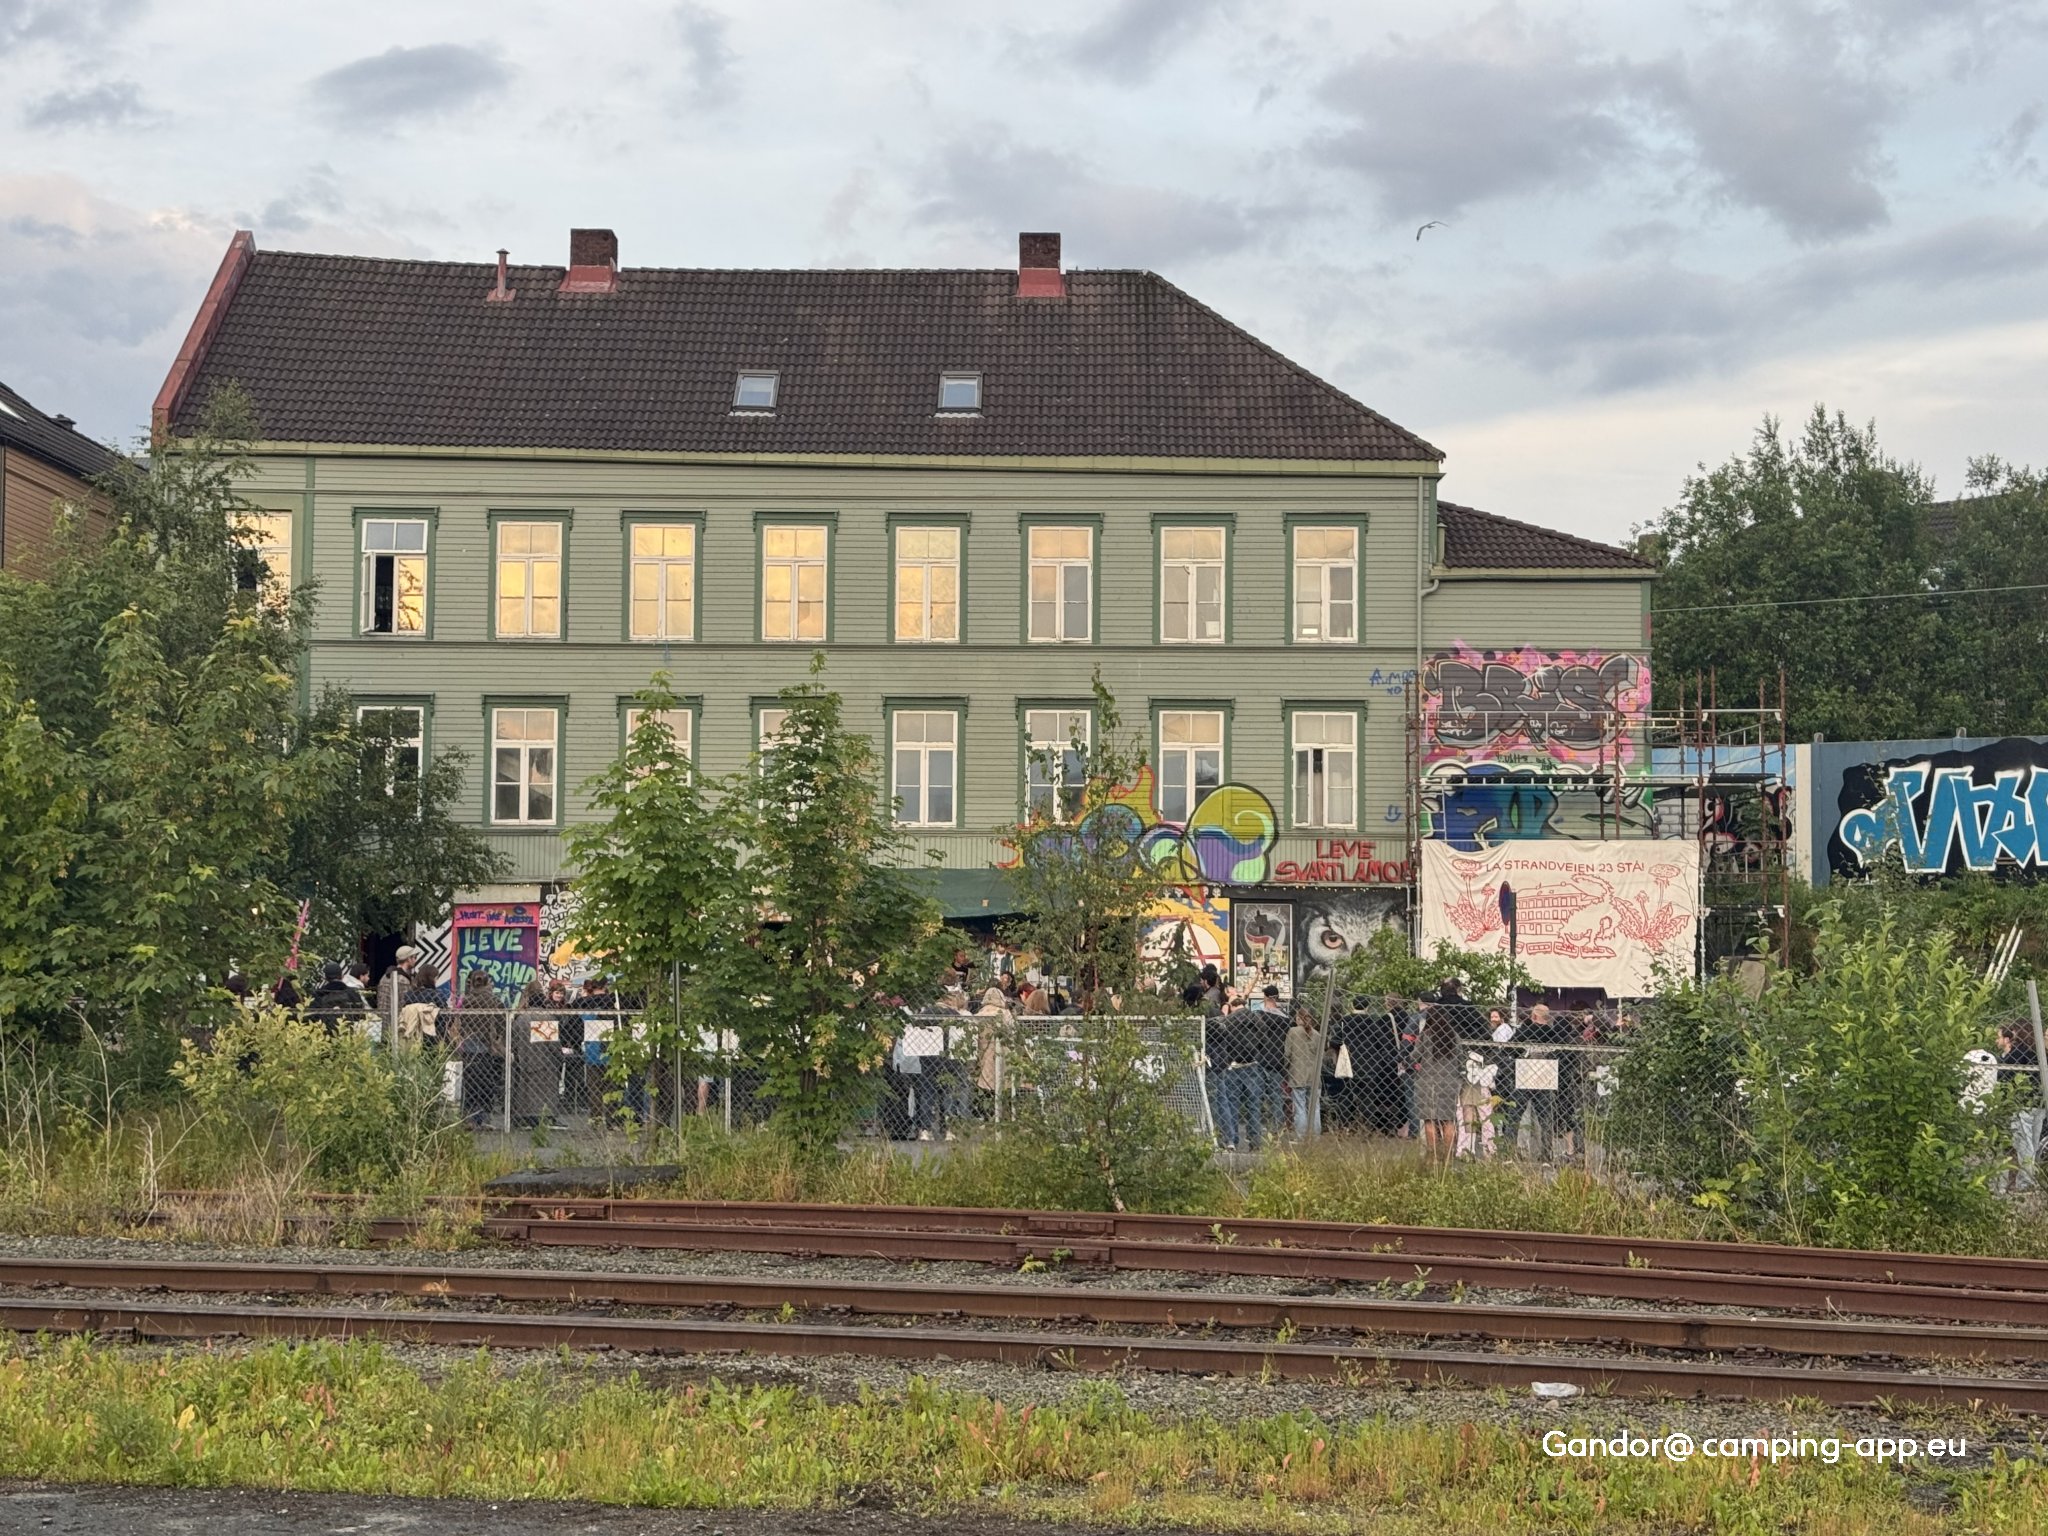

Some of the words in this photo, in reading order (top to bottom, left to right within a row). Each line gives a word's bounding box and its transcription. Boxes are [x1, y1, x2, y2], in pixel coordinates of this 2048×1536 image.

[1316, 838, 1377, 859] LEVE
[1486, 863, 1501, 872] LA
[1504, 860, 1595, 873] STRANDVEIEN
[1598, 863, 1613, 873] 23
[464, 928, 523, 953] LEVE
